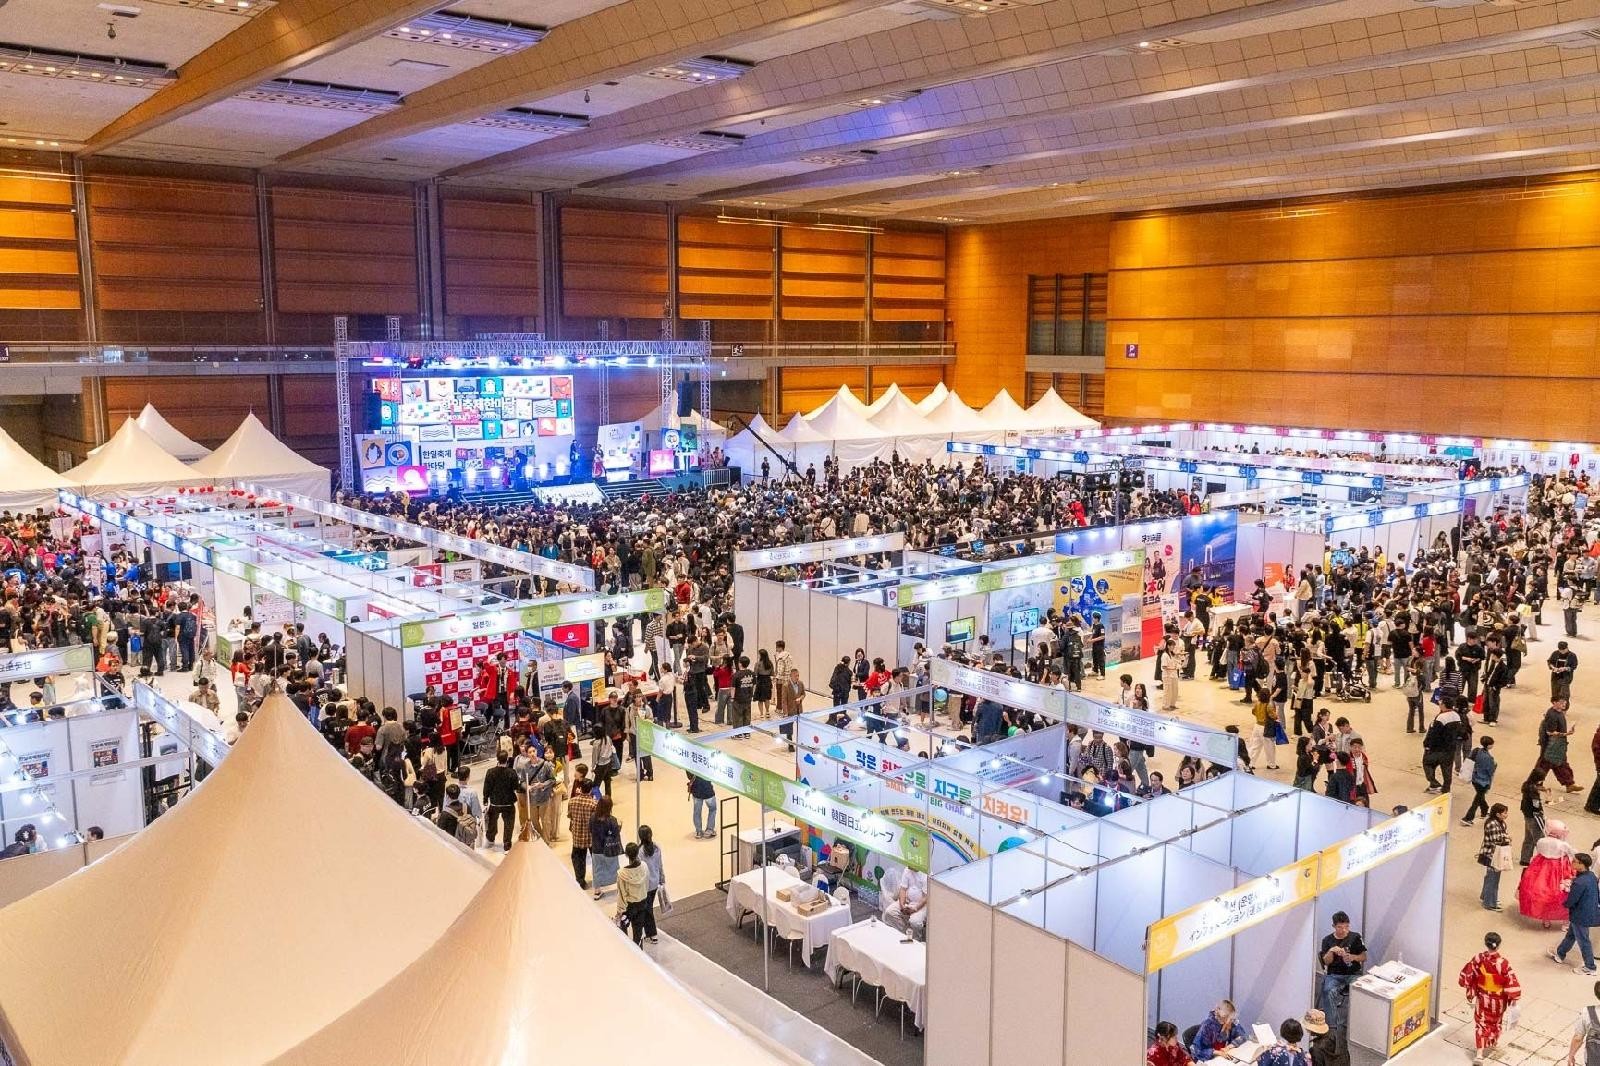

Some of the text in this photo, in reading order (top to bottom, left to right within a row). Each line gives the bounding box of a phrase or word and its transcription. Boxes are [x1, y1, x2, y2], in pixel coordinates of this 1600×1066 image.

[422, 450, 452, 459] 한일축제
[856, 750, 877, 770] 작은
[934, 778, 972, 801] 지구를
[791, 794, 826, 817] HITACHI
